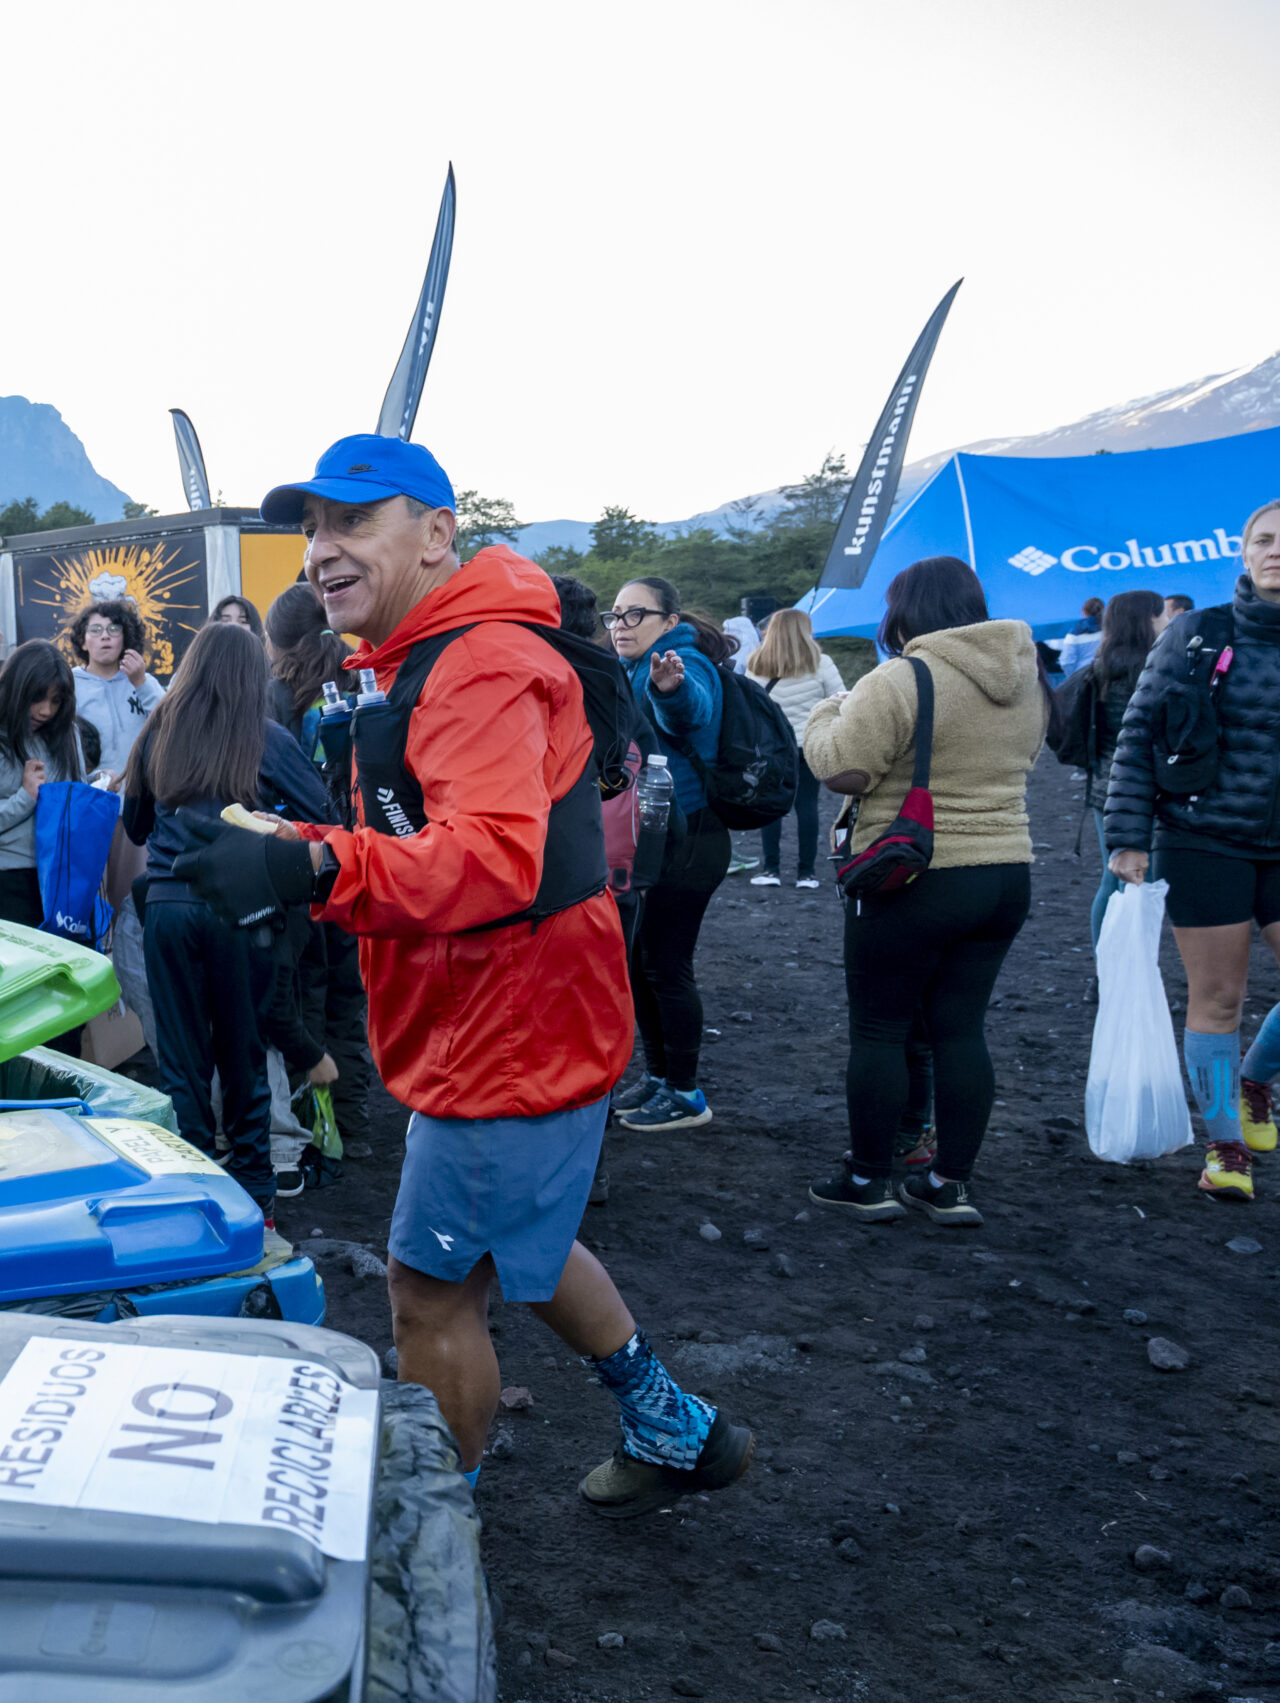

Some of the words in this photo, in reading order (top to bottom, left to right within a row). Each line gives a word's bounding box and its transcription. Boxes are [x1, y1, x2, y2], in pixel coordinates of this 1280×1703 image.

[844, 375, 917, 556] kunstmann
[1060, 528, 1243, 572] Columb
[120, 1135, 176, 1164] PAPEL
[108, 1382, 234, 1470] NO
[261, 1365, 346, 1544] RECICLABLES
